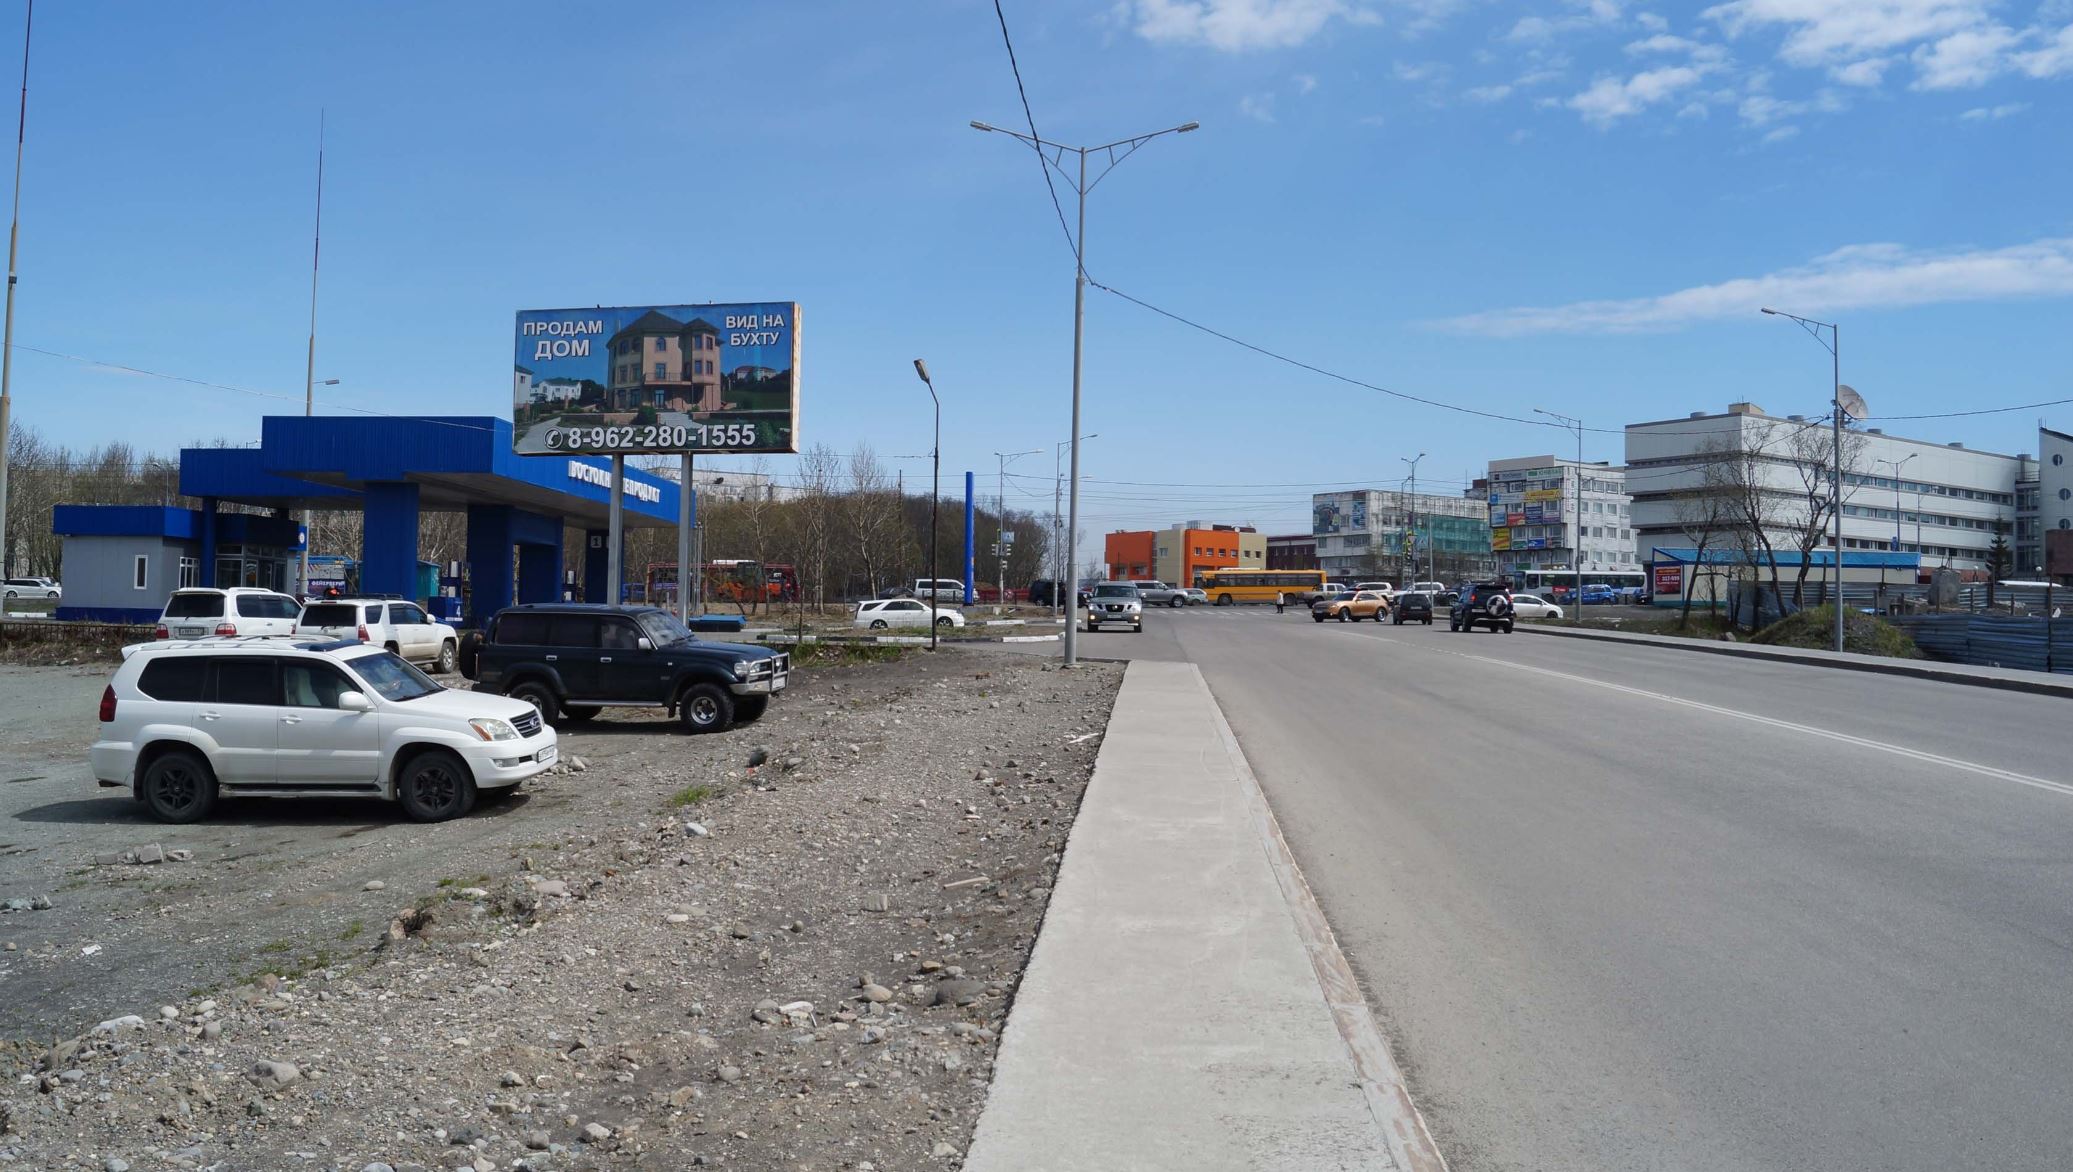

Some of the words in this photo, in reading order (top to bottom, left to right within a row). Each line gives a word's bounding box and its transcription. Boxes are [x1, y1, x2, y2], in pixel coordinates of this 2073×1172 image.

[522, 319, 604, 338] ПРОДАМ
[725, 315, 759, 331] ВИД
[762, 313, 785, 328] НА
[730, 331, 780, 347] БУХТУ
[534, 339, 590, 361] ДОМ
[567, 424, 756, 449] 8-962-280-1555
